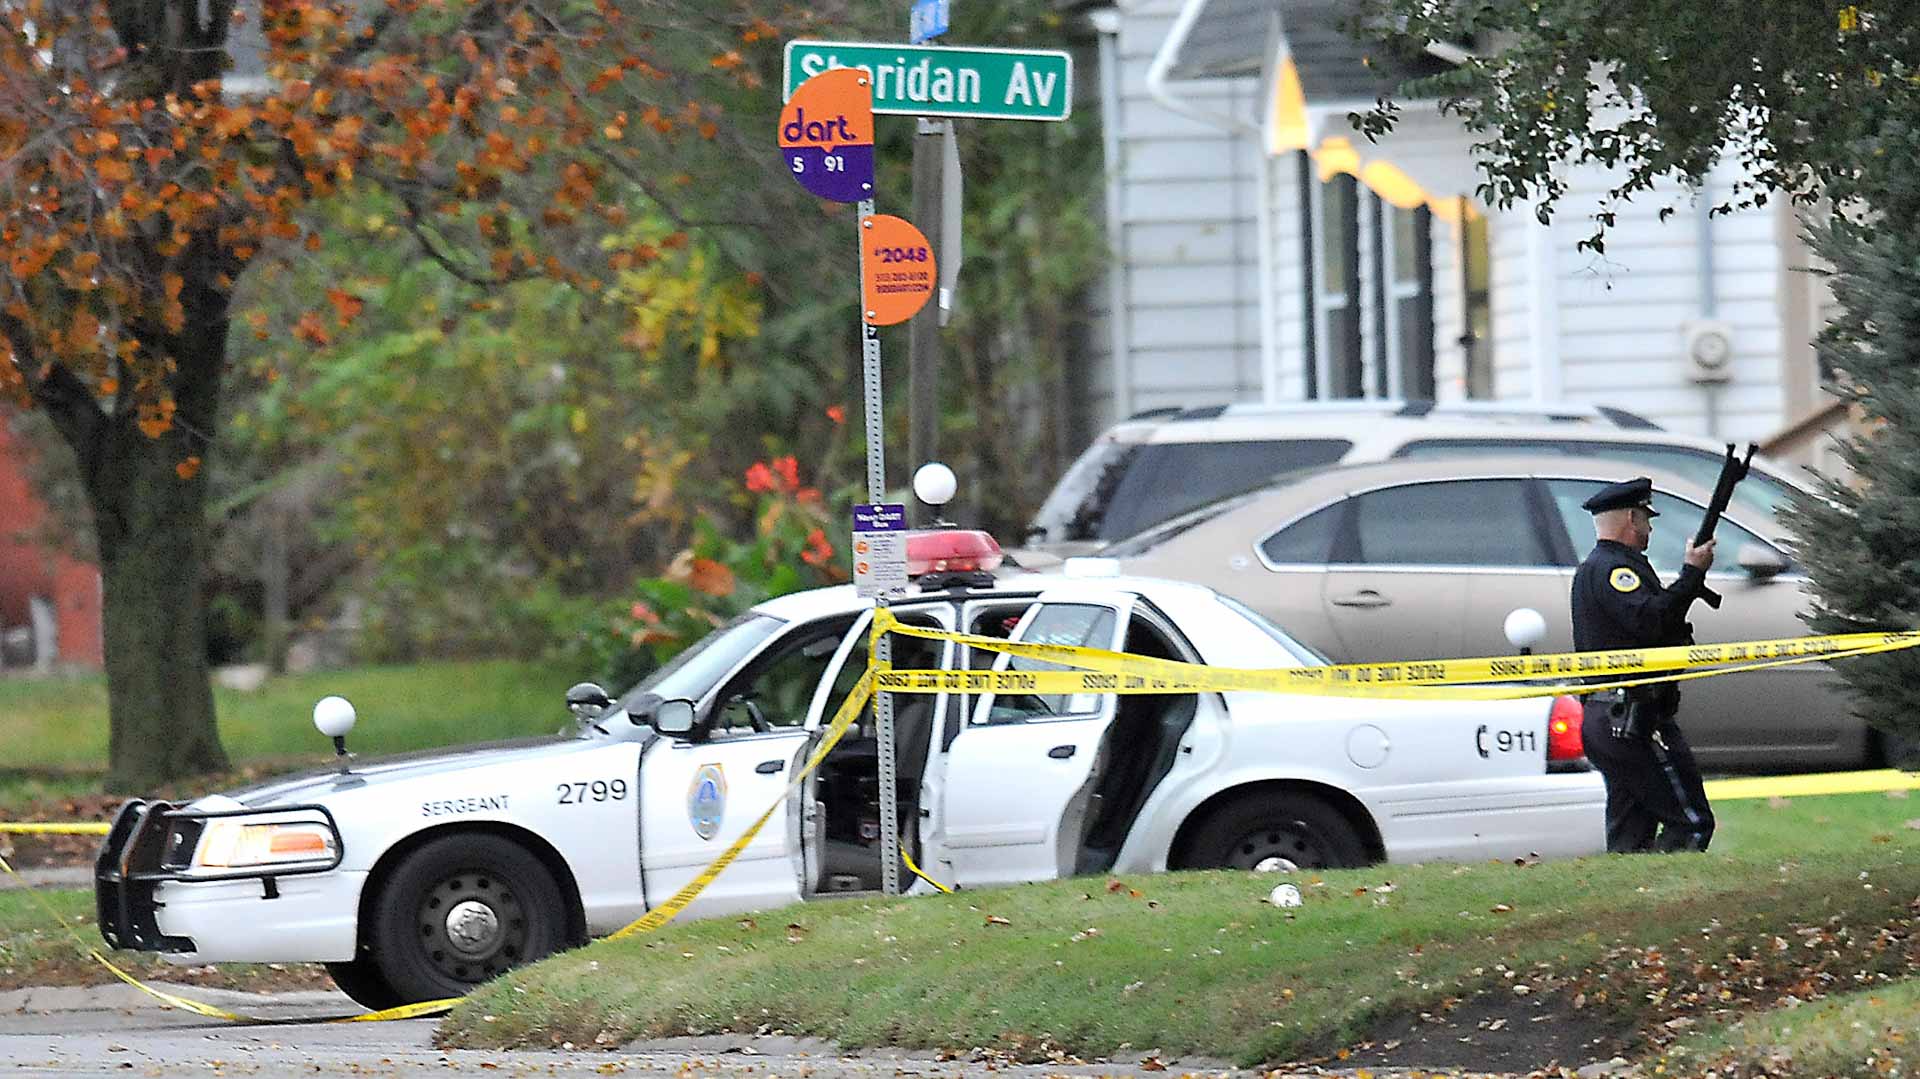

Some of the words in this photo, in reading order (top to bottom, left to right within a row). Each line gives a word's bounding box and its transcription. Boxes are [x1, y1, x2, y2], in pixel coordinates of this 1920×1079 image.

[801, 52, 981, 103] Sridan
[1005, 60, 1057, 107] Av
[824, 156, 844, 172] 91
[1531, 658, 1552, 673] NOT
[1557, 657, 1572, 672] DO
[1578, 655, 1601, 671] LINE
[917, 673, 937, 687] NOT
[944, 673, 960, 687] DO
[966, 674, 990, 688] LINE
[996, 674, 1036, 689] POLICE
[1356, 667, 1371, 682] DO
[1377, 666, 1401, 682] LINE
[1496, 730, 1536, 752] 911
[557, 778, 628, 805] 2799
[421, 795, 510, 817] SERGEANT
